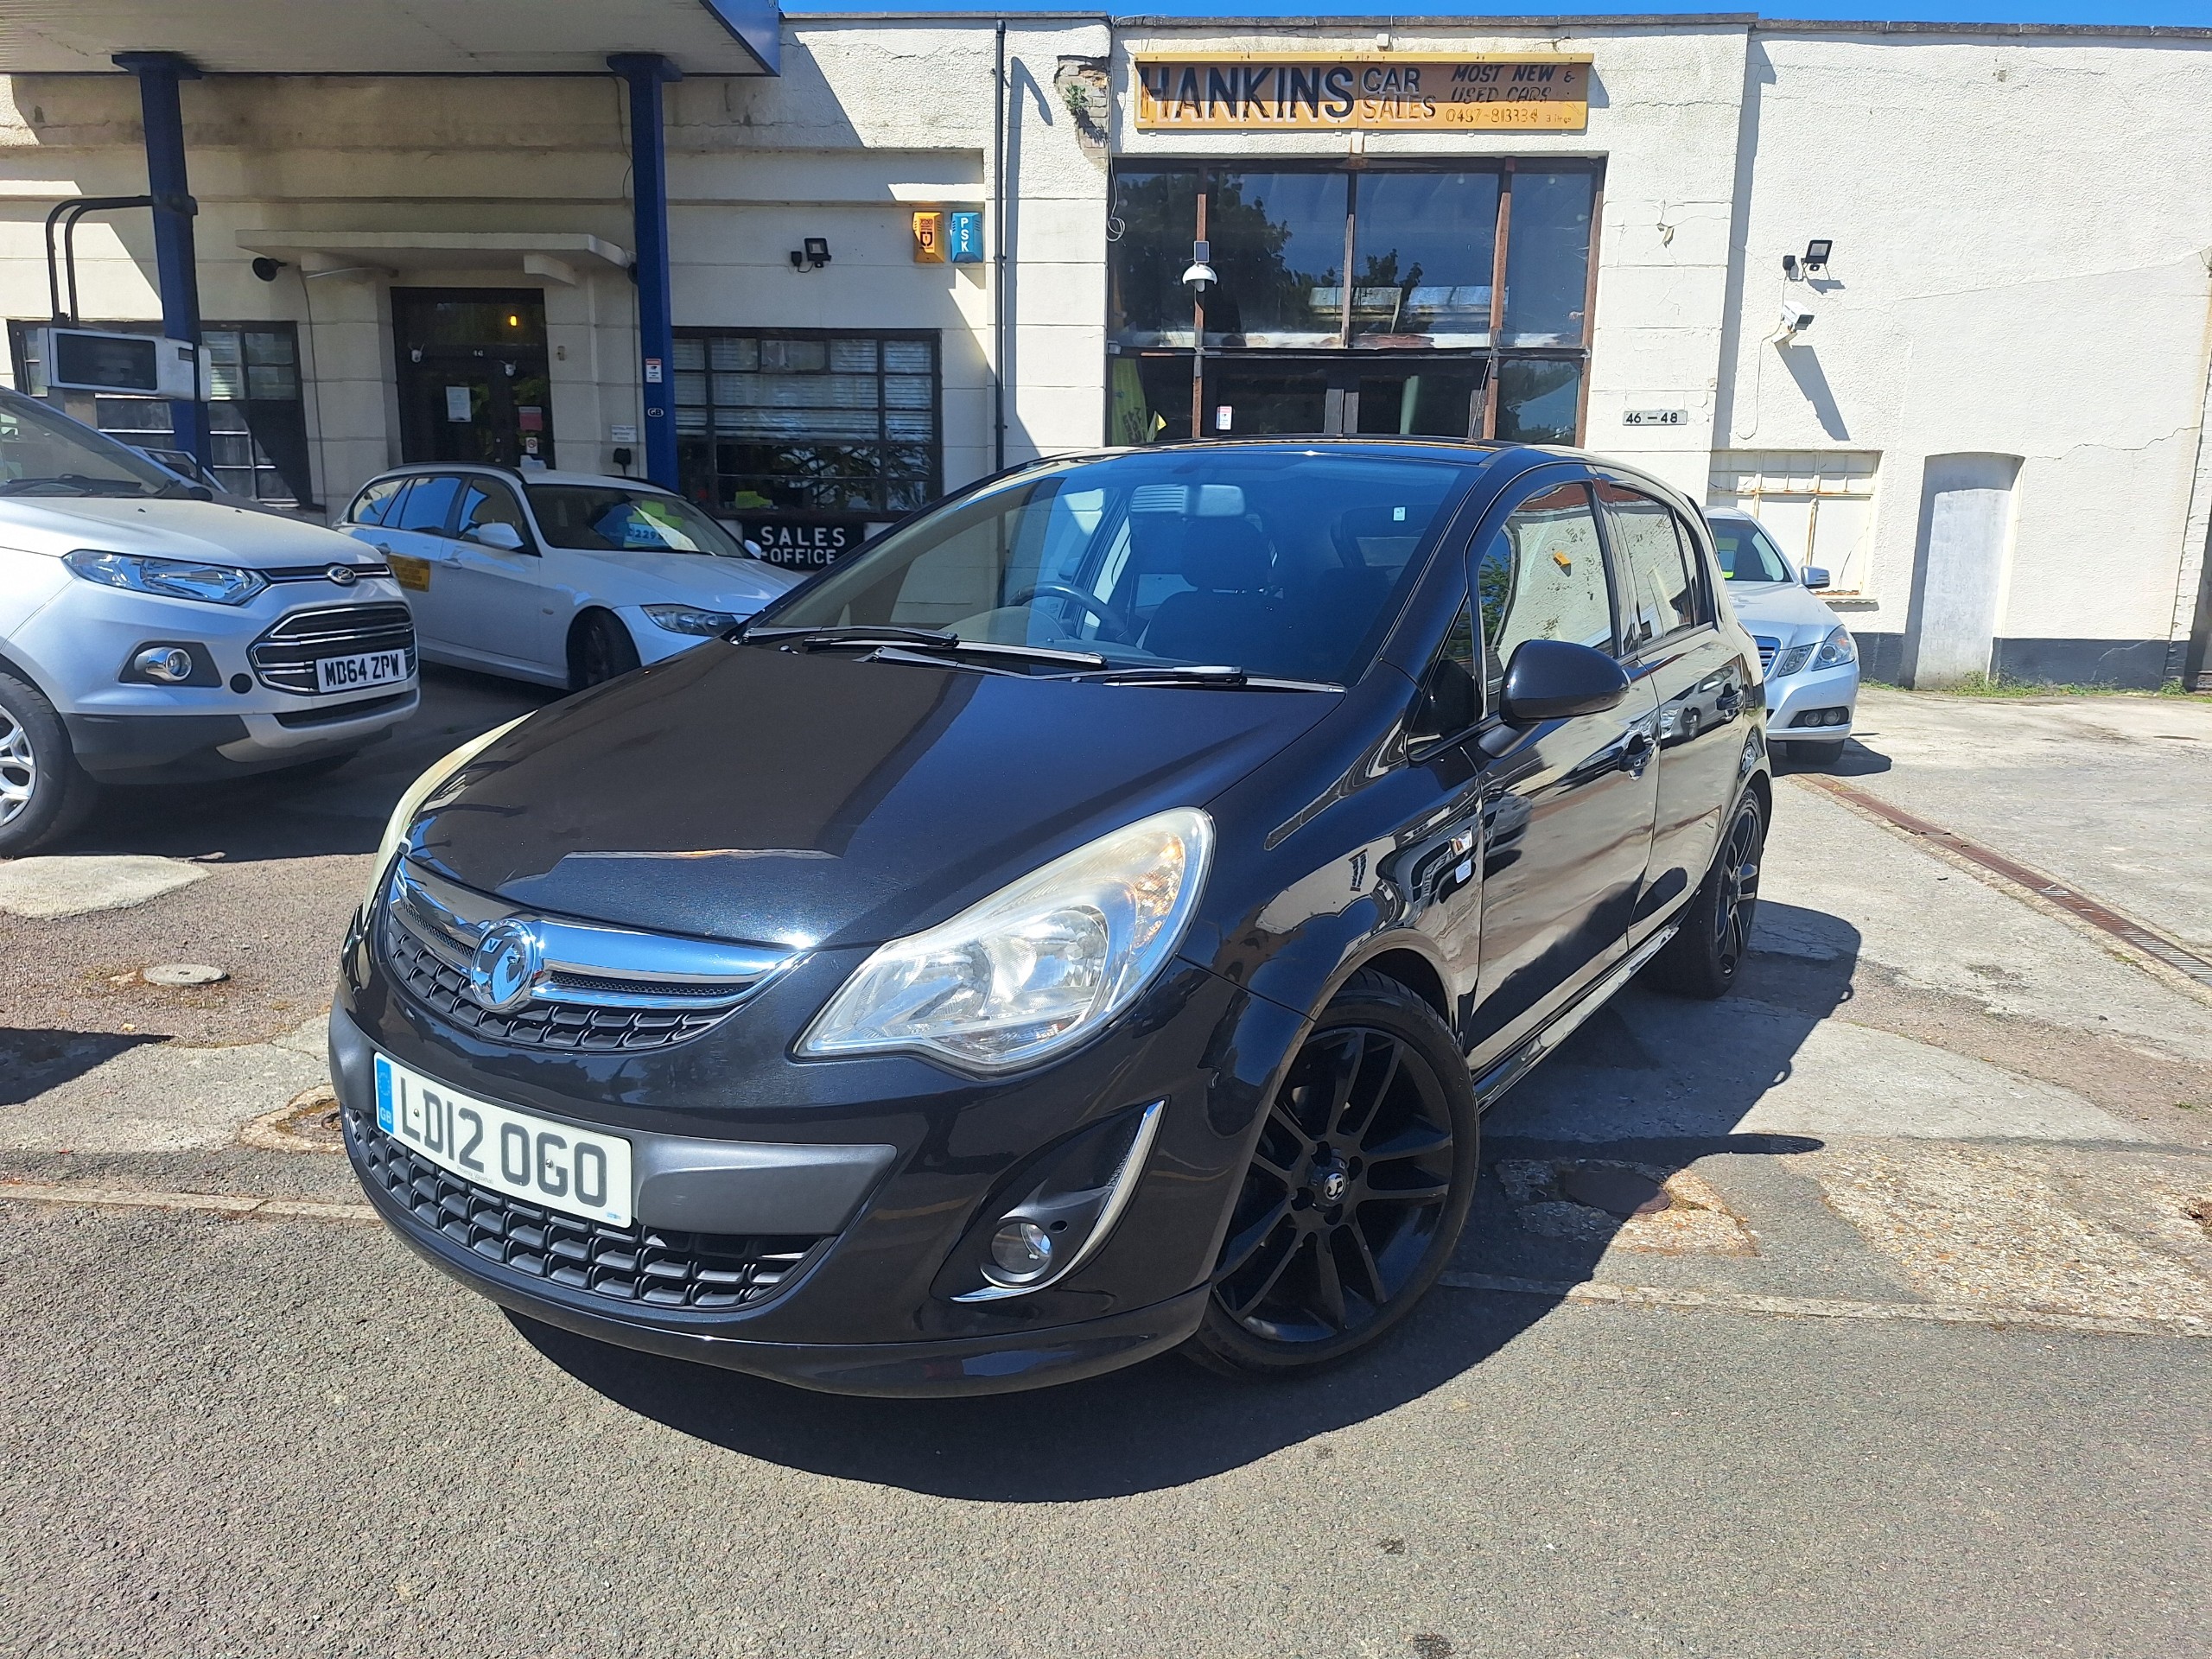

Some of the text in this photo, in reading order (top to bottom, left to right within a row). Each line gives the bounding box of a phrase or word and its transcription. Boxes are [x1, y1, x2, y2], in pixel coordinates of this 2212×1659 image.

[1363, 67, 1421, 92] CAR
[1451, 64, 1576, 83] MOST NEW &
[1138, 66, 1356, 120] HANKINS
[1451, 86, 1552, 104] USED CARS
[1363, 94, 1436, 119] SALES
[960, 217, 969, 252] PSK
[1626, 413, 1642, 423] 46
[1660, 412, 1678, 423] 48
[760, 525, 846, 547] SALES
[770, 547, 836, 565] OFFICE
[325, 653, 399, 686] MD64 ZPW
[380, 1106, 392, 1125] GB
[400, 1077, 607, 1208] LD12 OGO
